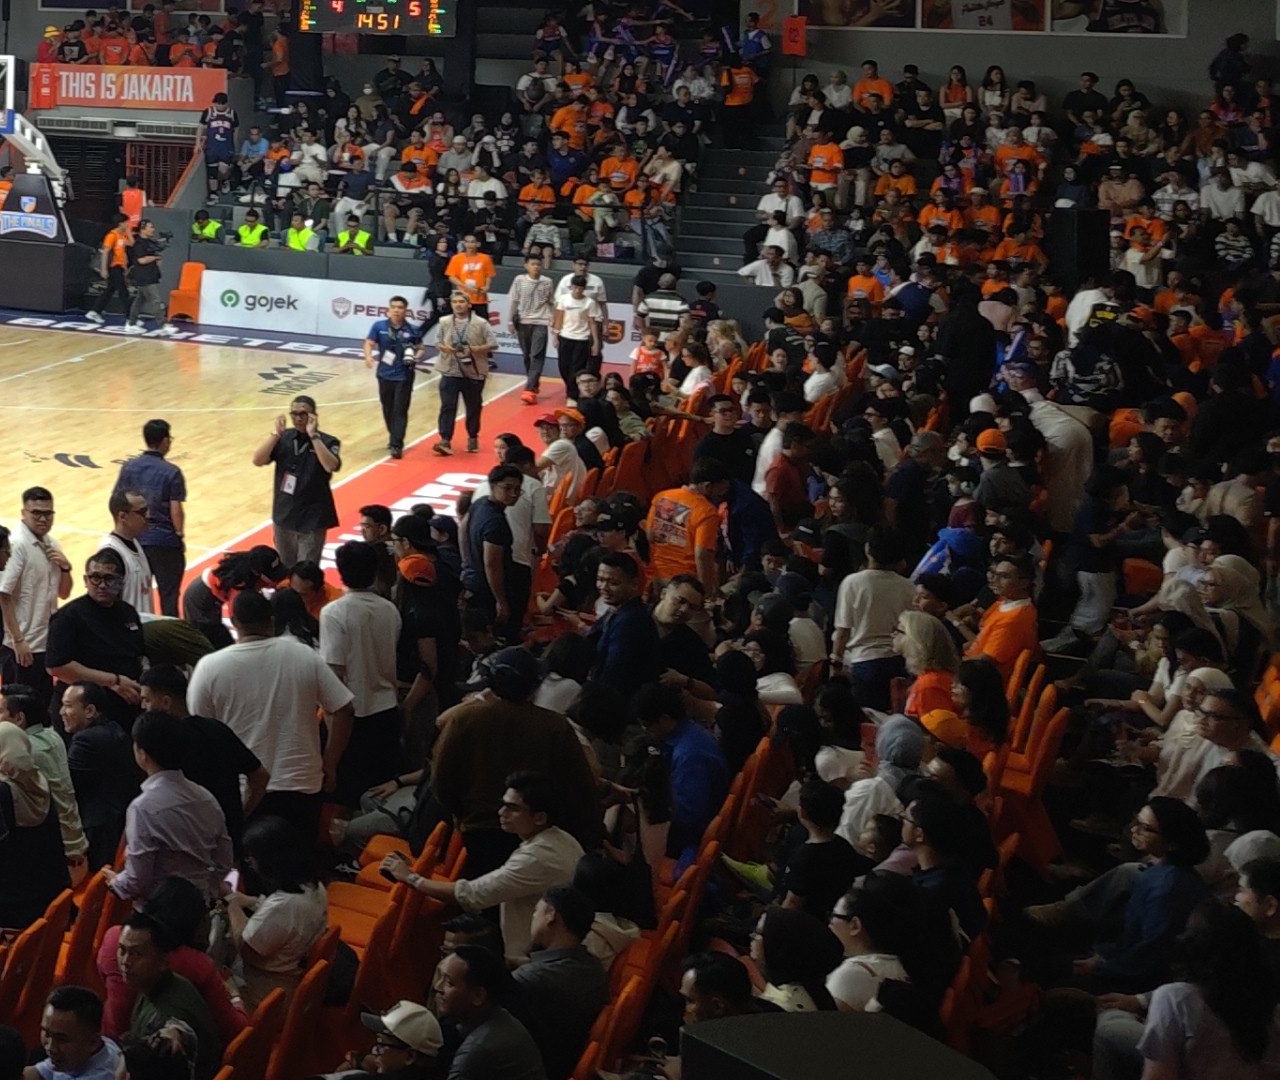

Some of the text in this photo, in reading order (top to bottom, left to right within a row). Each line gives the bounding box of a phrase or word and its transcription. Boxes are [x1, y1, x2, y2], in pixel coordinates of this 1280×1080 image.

[332, 0, 344, 13] 4
[409, 1, 422, 16] 5
[59, 71, 194, 102] THIS IS JAKARTA
[244, 295, 299, 313] gojek
